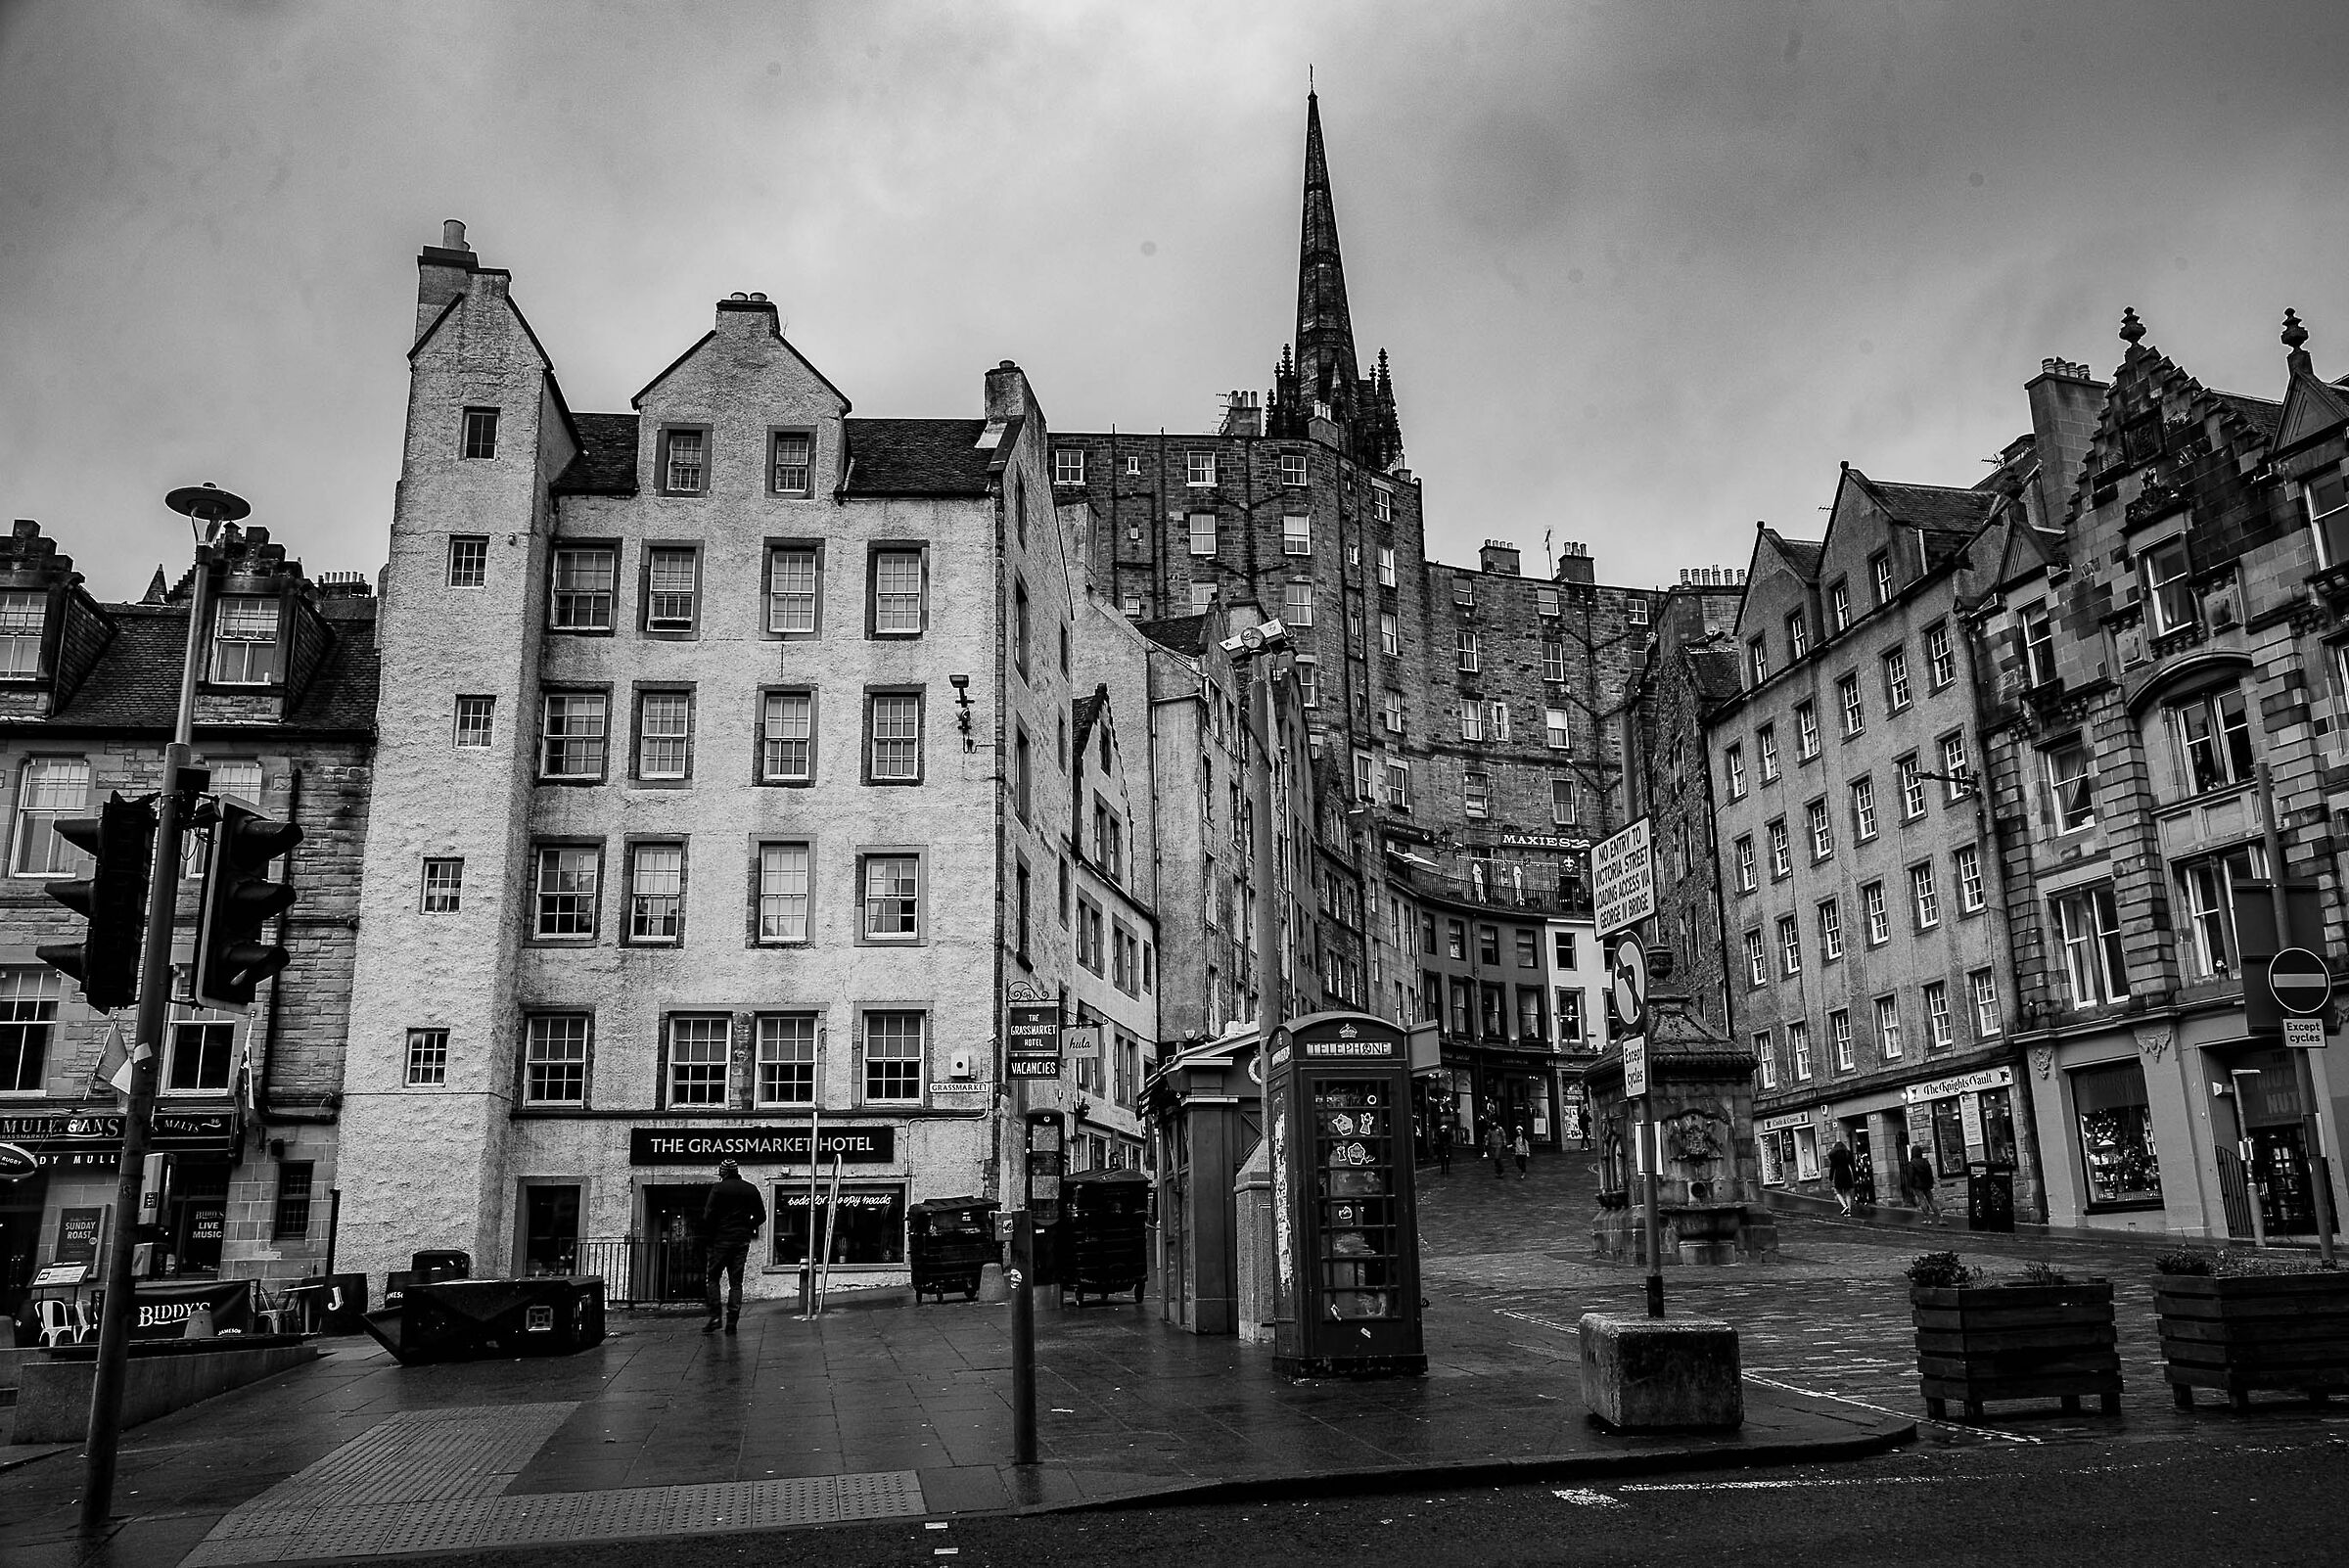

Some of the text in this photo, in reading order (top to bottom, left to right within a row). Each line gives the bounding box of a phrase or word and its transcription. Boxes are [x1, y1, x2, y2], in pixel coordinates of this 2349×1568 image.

[1502, 834, 1571, 848] MAXIES
[1598, 825, 1641, 864] NO ENTRY TO
[1594, 845, 1648, 888] VICTORIA STREET
[1595, 868, 1651, 910] LOADING ACCESS VIA
[1599, 905, 1622, 930] GEORGE
[1628, 892, 1649, 918] BRIDGE
[1010, 1024, 1057, 1036] GRASSMARKET
[2286, 1022, 2321, 1032] Except
[1024, 1038, 1044, 1047] HOTEL
[1069, 1037, 1091, 1050] hula
[2290, 1033, 2321, 1043] cycles
[1312, 1043, 1390, 1055] TELEPHONE
[1625, 1044, 1643, 1064] Except
[1010, 1061, 1057, 1075] VACANCIES
[1627, 1067, 1643, 1092] cycles
[1923, 1073, 1993, 1095] The Knights Vault
[650, 1136, 875, 1153] THE GRASSMARKET HOTEL
[65, 1221, 96, 1230] SUNDAY
[67, 1230, 93, 1240] ROAST
[192, 1230, 222, 1239] MUSIC
